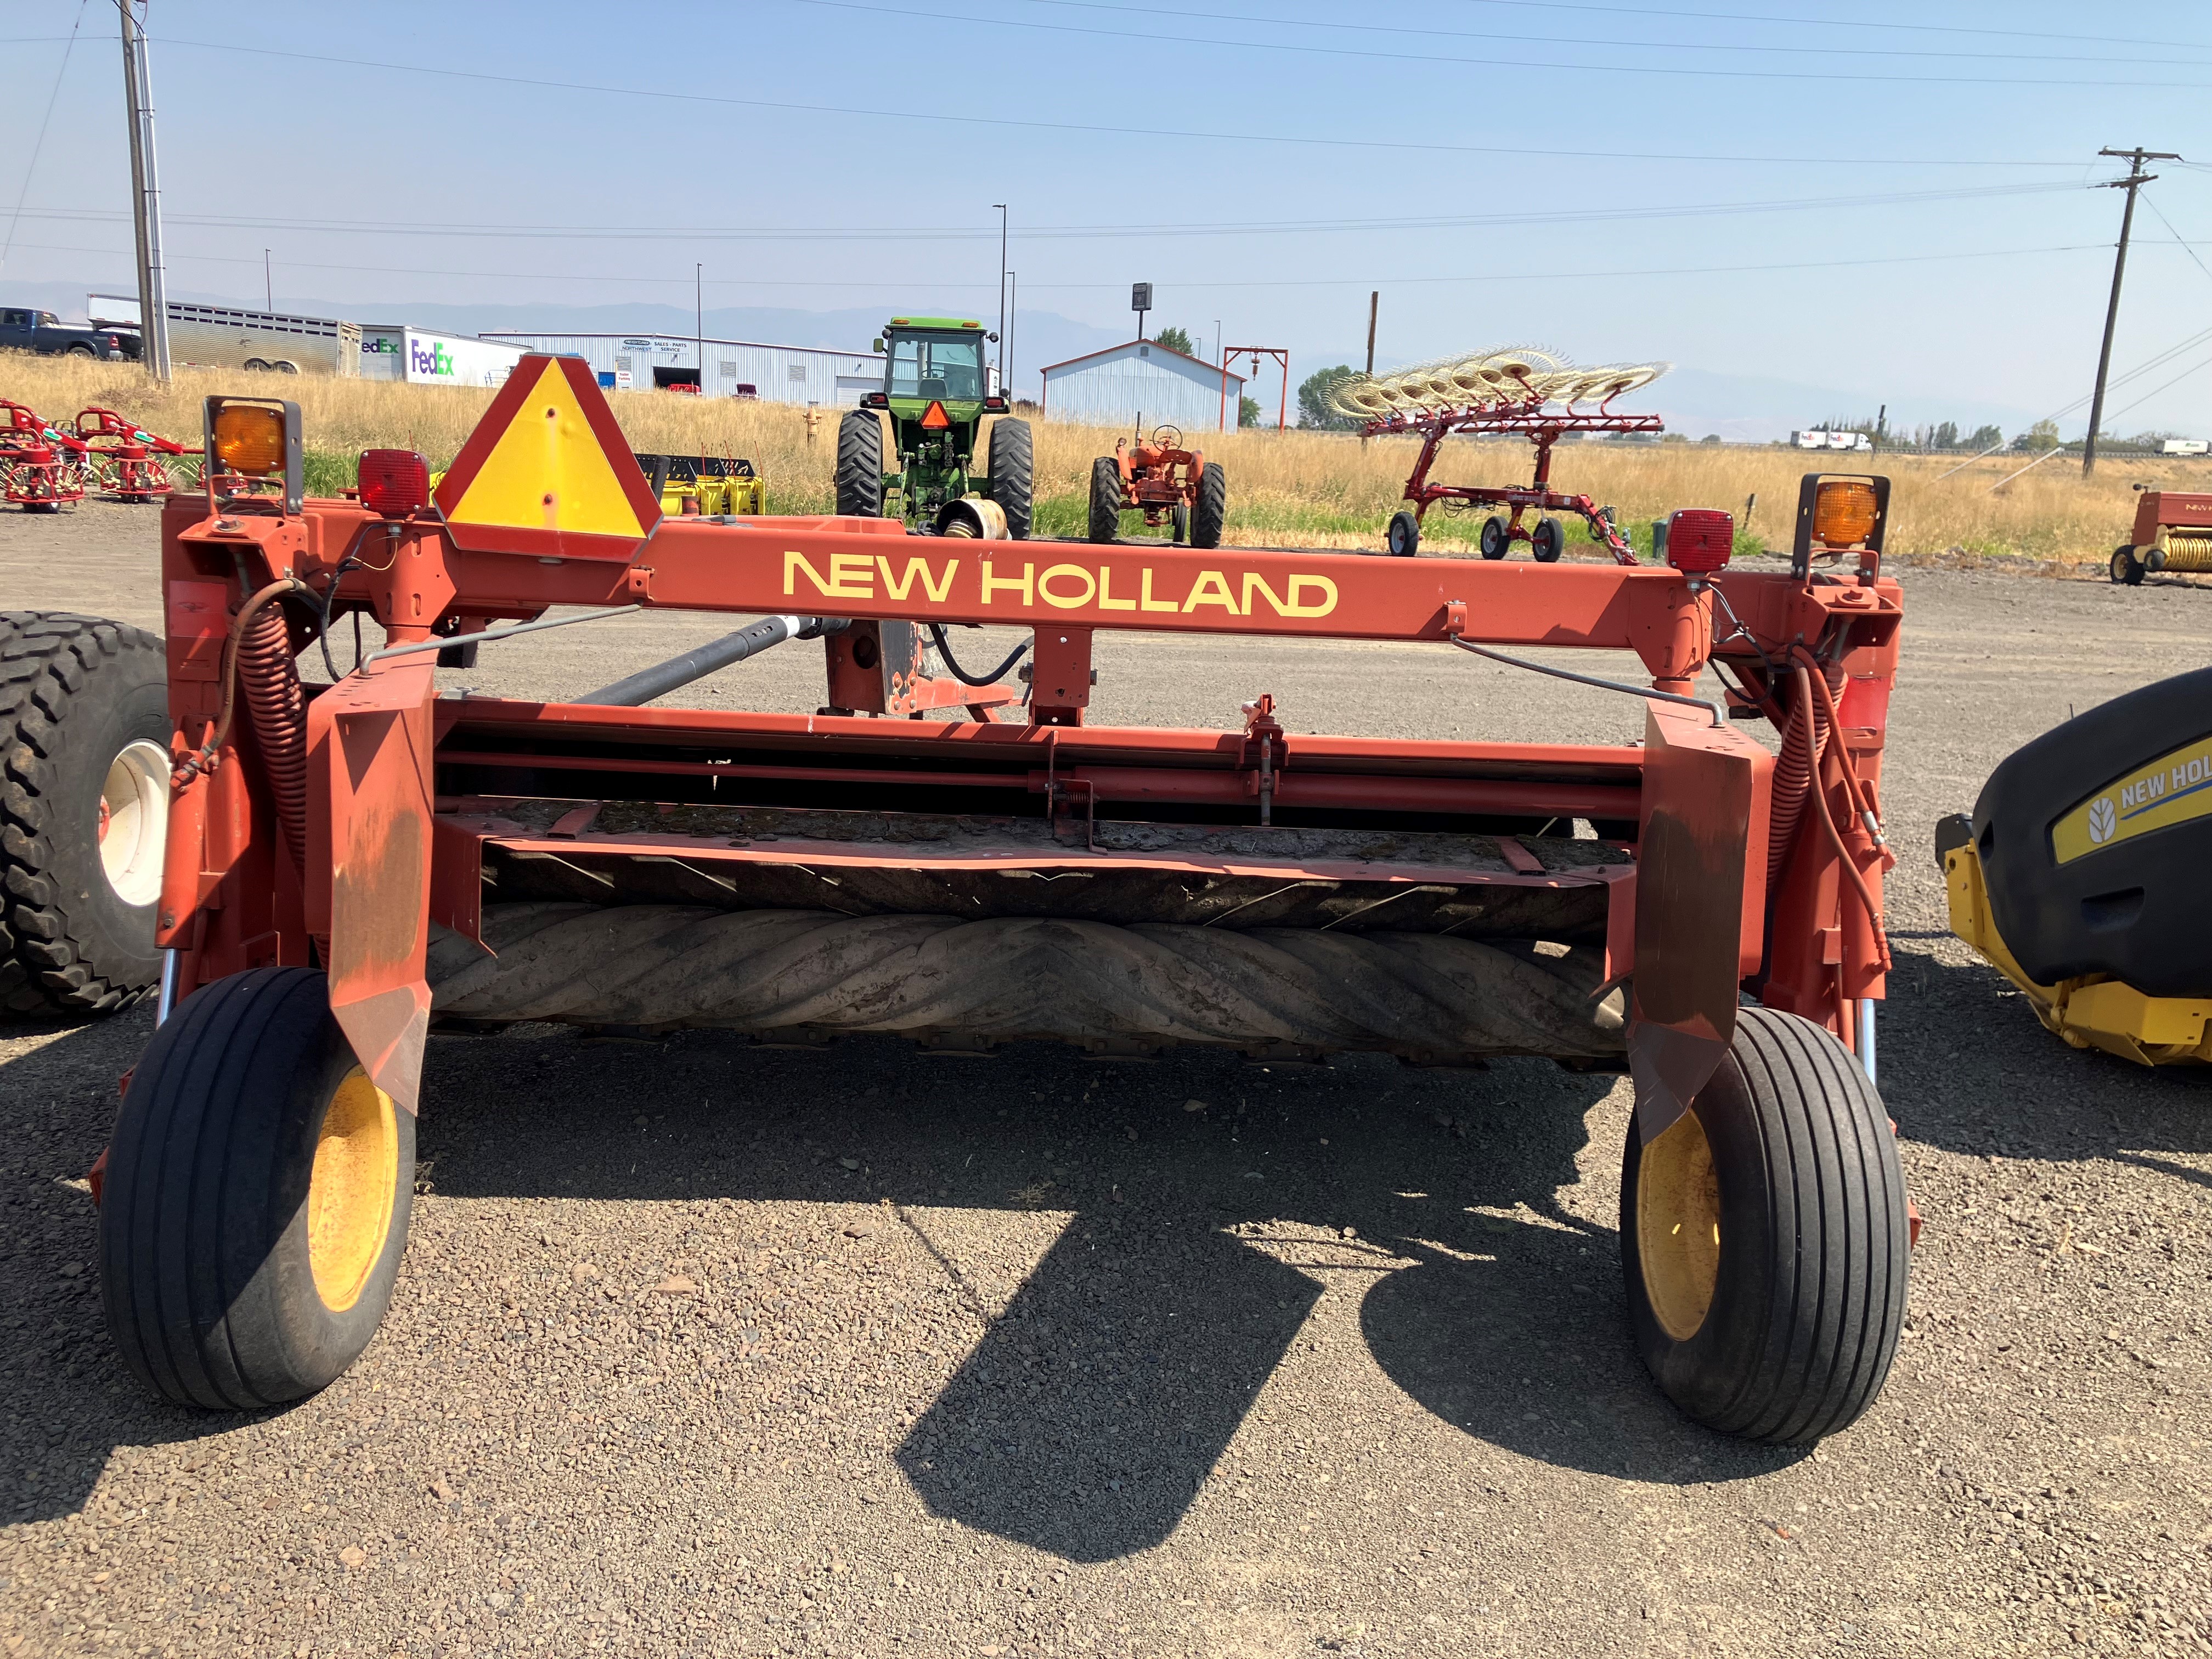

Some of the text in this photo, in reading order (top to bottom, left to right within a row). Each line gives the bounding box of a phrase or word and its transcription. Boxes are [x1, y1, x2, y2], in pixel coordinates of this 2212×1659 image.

[362, 338, 399, 354] edEx
[411, 339, 454, 376] FedEx
[783, 550, 1339, 618] NEW HOLLAND
[2121, 772, 2165, 809] NEW
